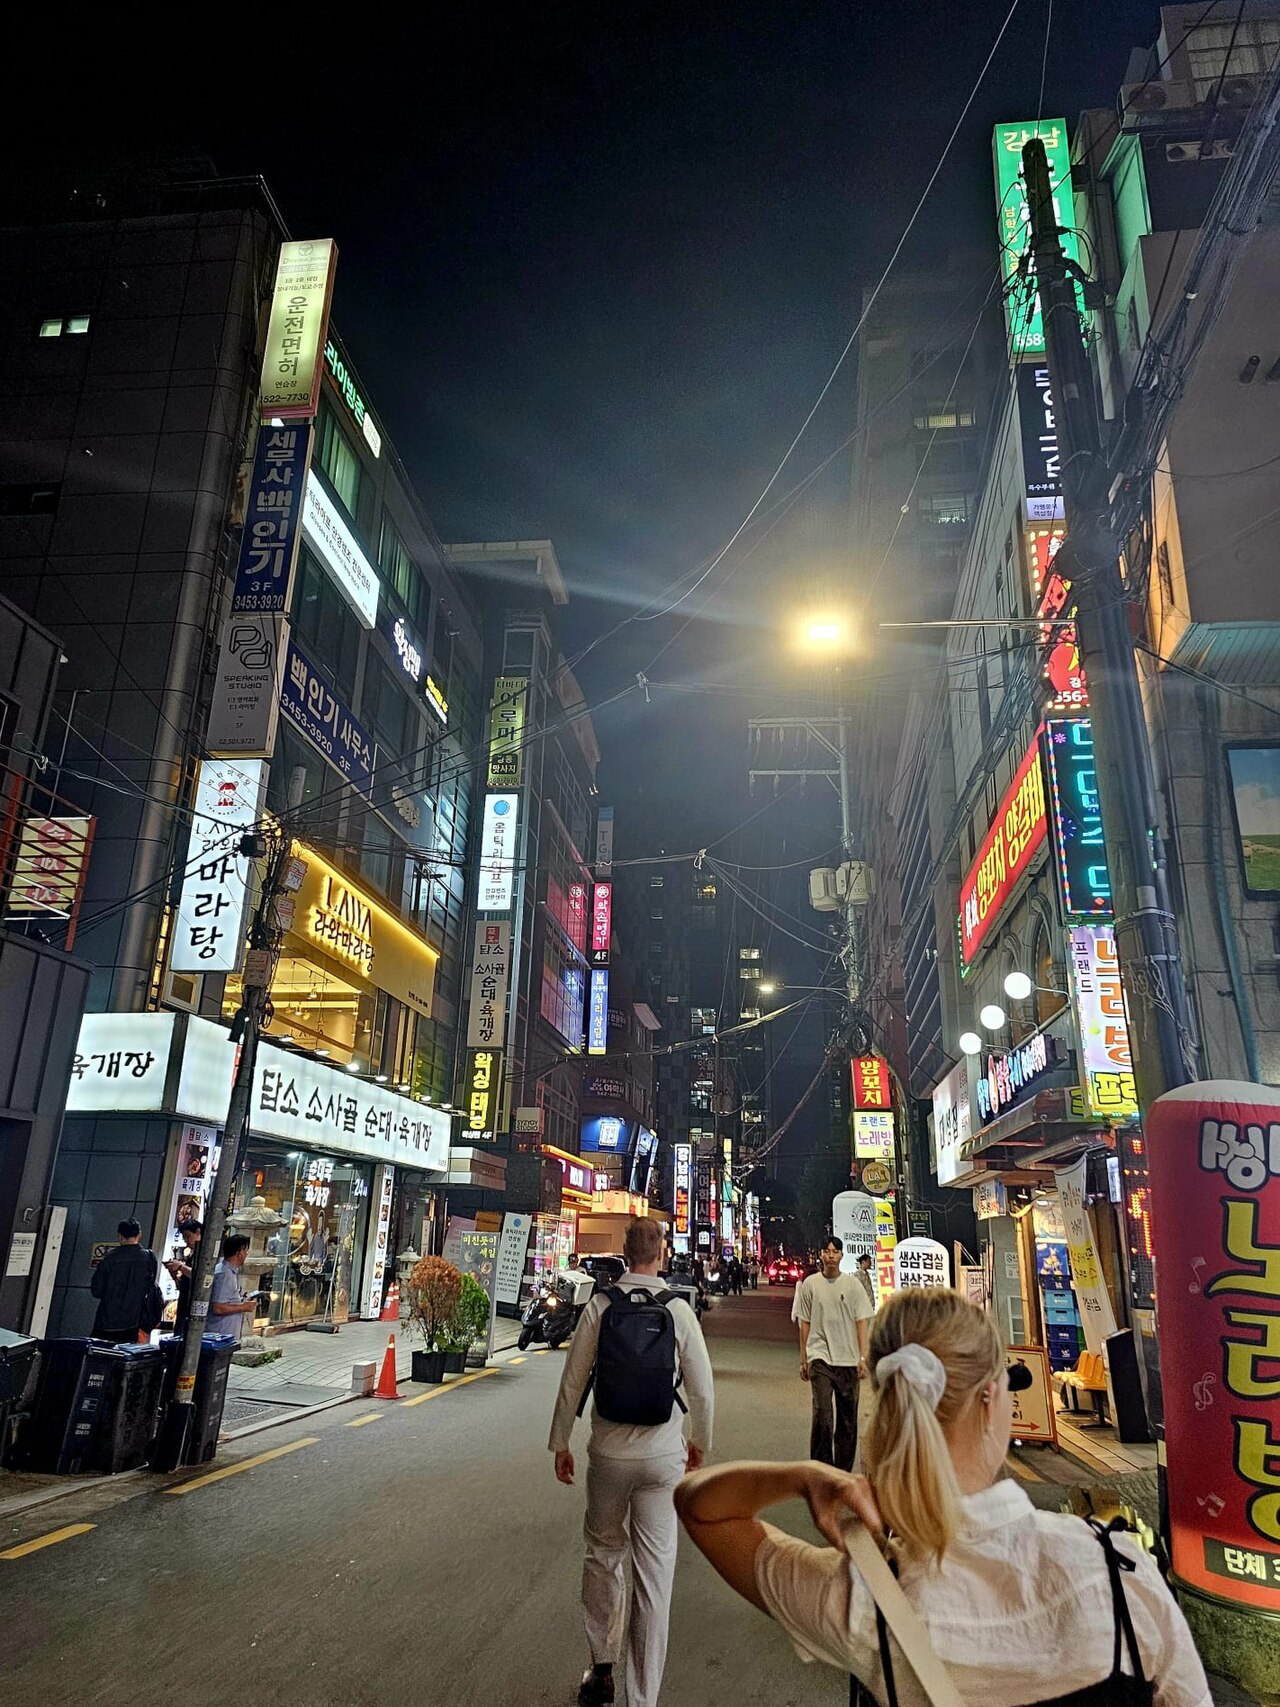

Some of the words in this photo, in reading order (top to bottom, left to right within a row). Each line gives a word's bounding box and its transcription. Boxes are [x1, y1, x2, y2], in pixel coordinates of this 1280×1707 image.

[277, 296, 308, 376] 운전면허
[275, 380, 297, 389] 연습장
[262, 431, 296, 484] 세무사
[245, 489, 292, 578] 백인기
[234, 595, 284, 609] 3453-3920
[250, 581, 272, 592] 3F
[282, 693, 333, 755] 3453-3920
[290, 653, 339, 738] 백인기
[341, 723, 371, 773] 사무소
[498, 692, 519, 741] 아로마
[338, 755, 352, 773] 3F
[492, 764, 516, 773] 맛사지
[1005, 751, 1045, 868] 양갈비
[977, 826, 1006, 920] 양꼬치
[189, 858, 236, 960] 마라탕
[314, 908, 376, 973] 라와마라탕
[479, 944, 505, 955] 담소
[594, 951, 607, 961] 4F
[593, 992, 604, 1039] 심리상담
[260, 1068, 300, 1118] 담소
[305, 1086, 359, 1134] 소사골
[860, 1060, 883, 1105] 양꼬치
[481, 1131, 493, 1139] 4F
[676, 1186, 688, 1233] 노래방
[463, 1234, 497, 1246] 미친듯이
[899, 1250, 944, 1271] 생삼겹살
[1224, 1547, 1266, 1582] 단체
